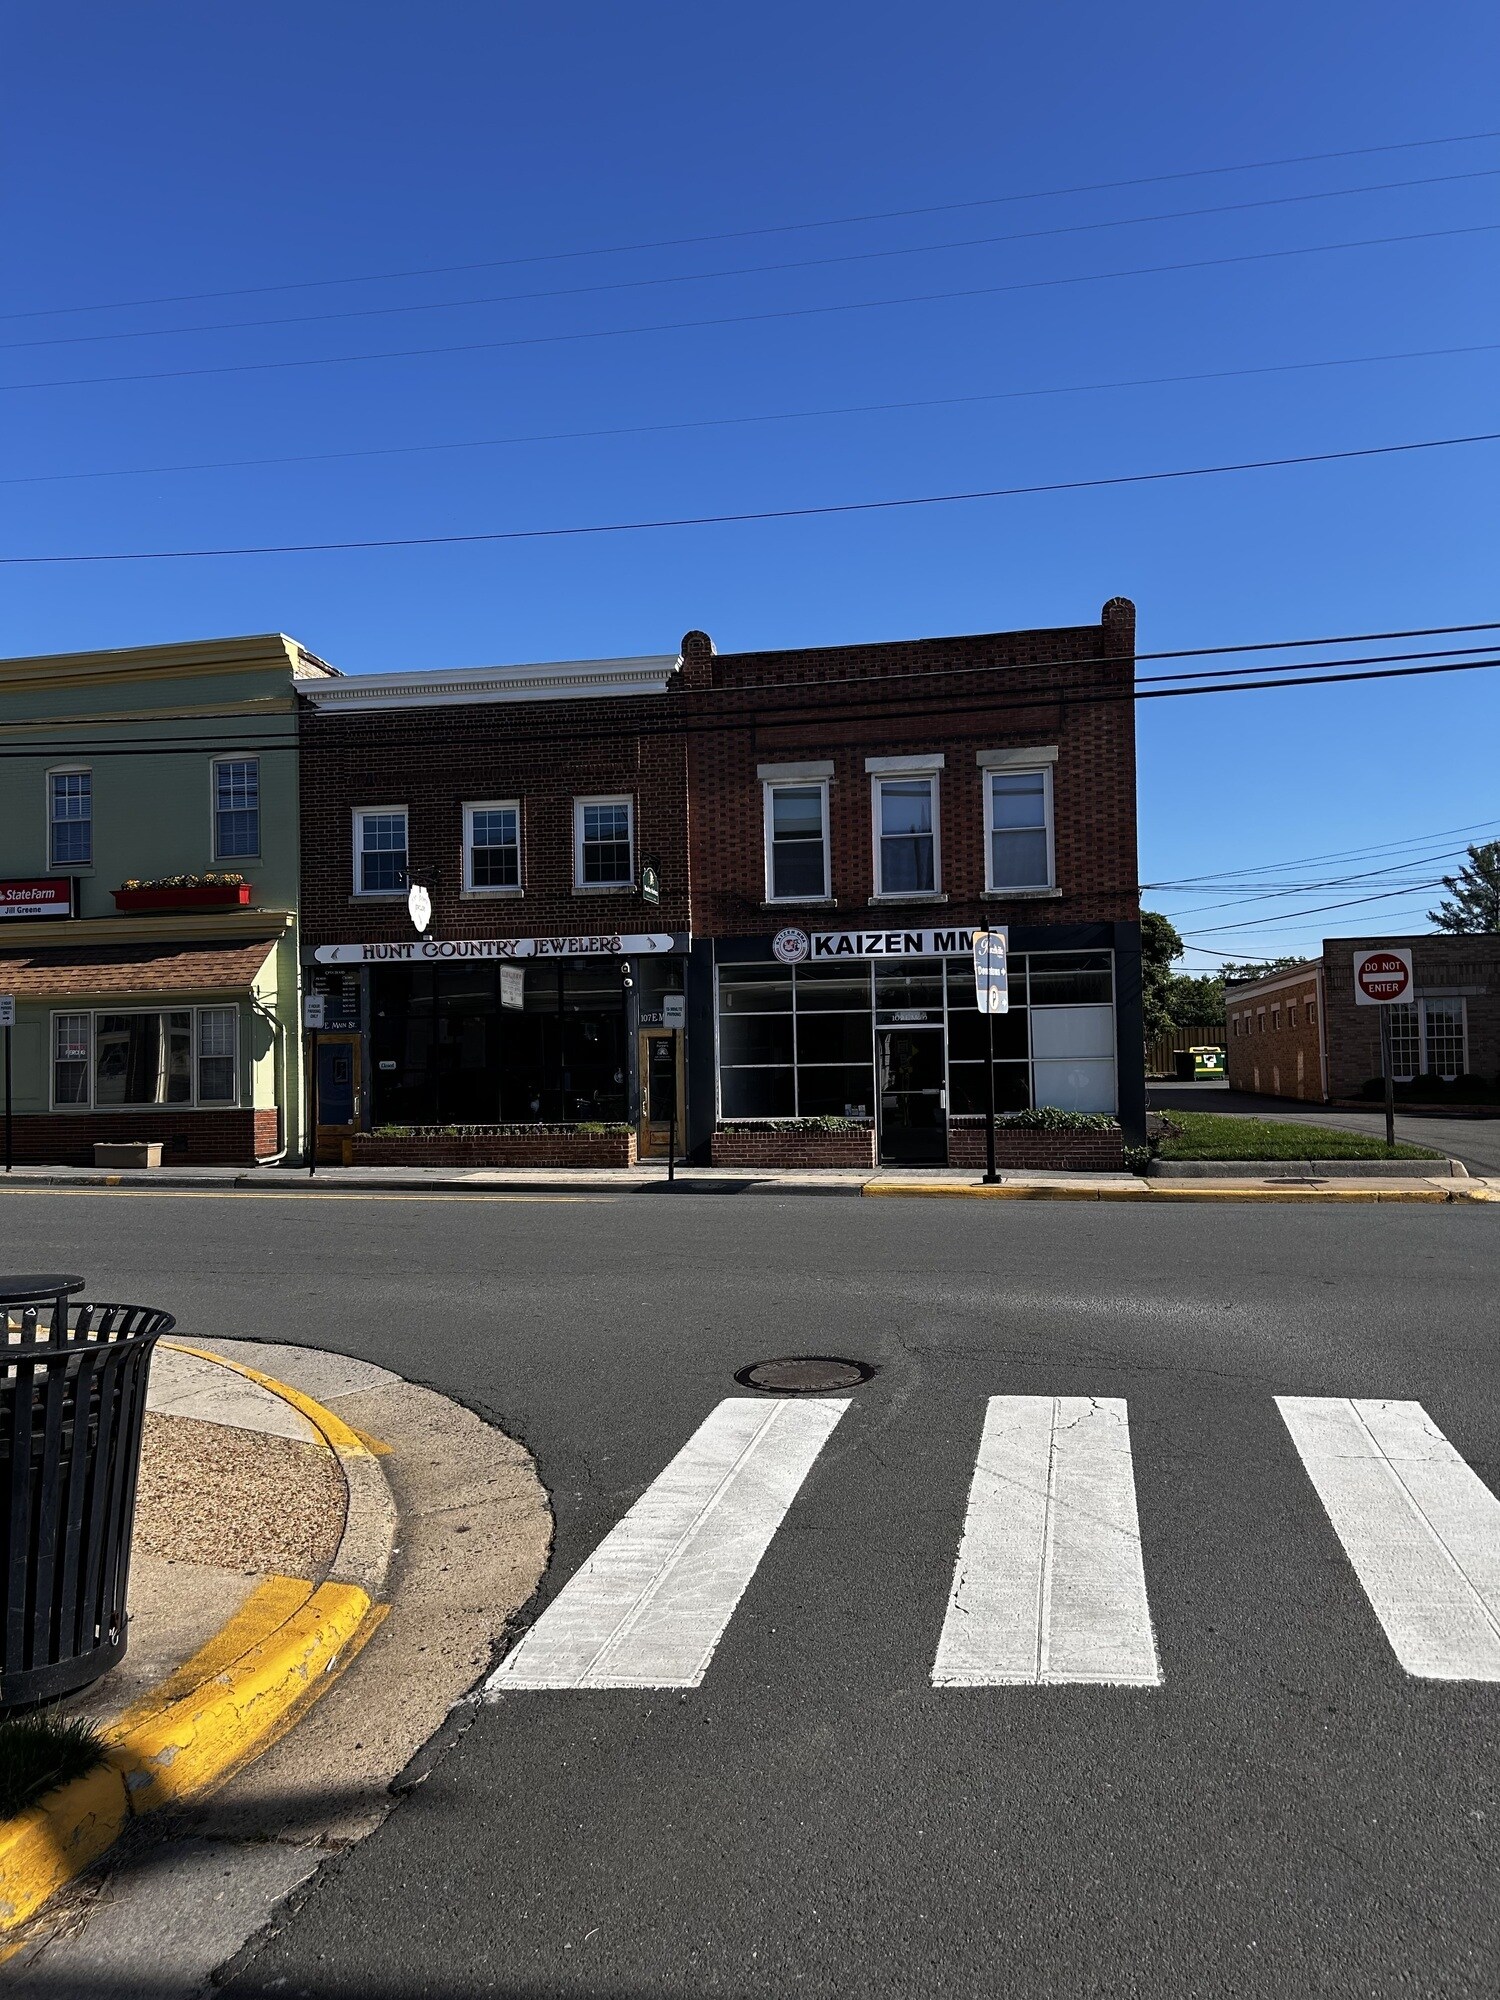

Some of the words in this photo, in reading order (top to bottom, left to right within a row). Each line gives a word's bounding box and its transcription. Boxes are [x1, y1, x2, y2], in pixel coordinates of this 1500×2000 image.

[17, 906, 41, 914] Greene
[776, 930, 795, 945] KAIZEN
[797, 932, 806, 943] MMA
[362, 944, 415, 960] HUNT
[422, 941, 520, 959] COUNTRY
[527, 936, 622, 957] JEWELERS
[814, 933, 923, 956] KAIZEN
[1365, 963, 1378, 971] DO
[1382, 961, 1400, 970] NOT
[1369, 983, 1399, 992] ENTER
[641, 1014, 651, 1022] 107
